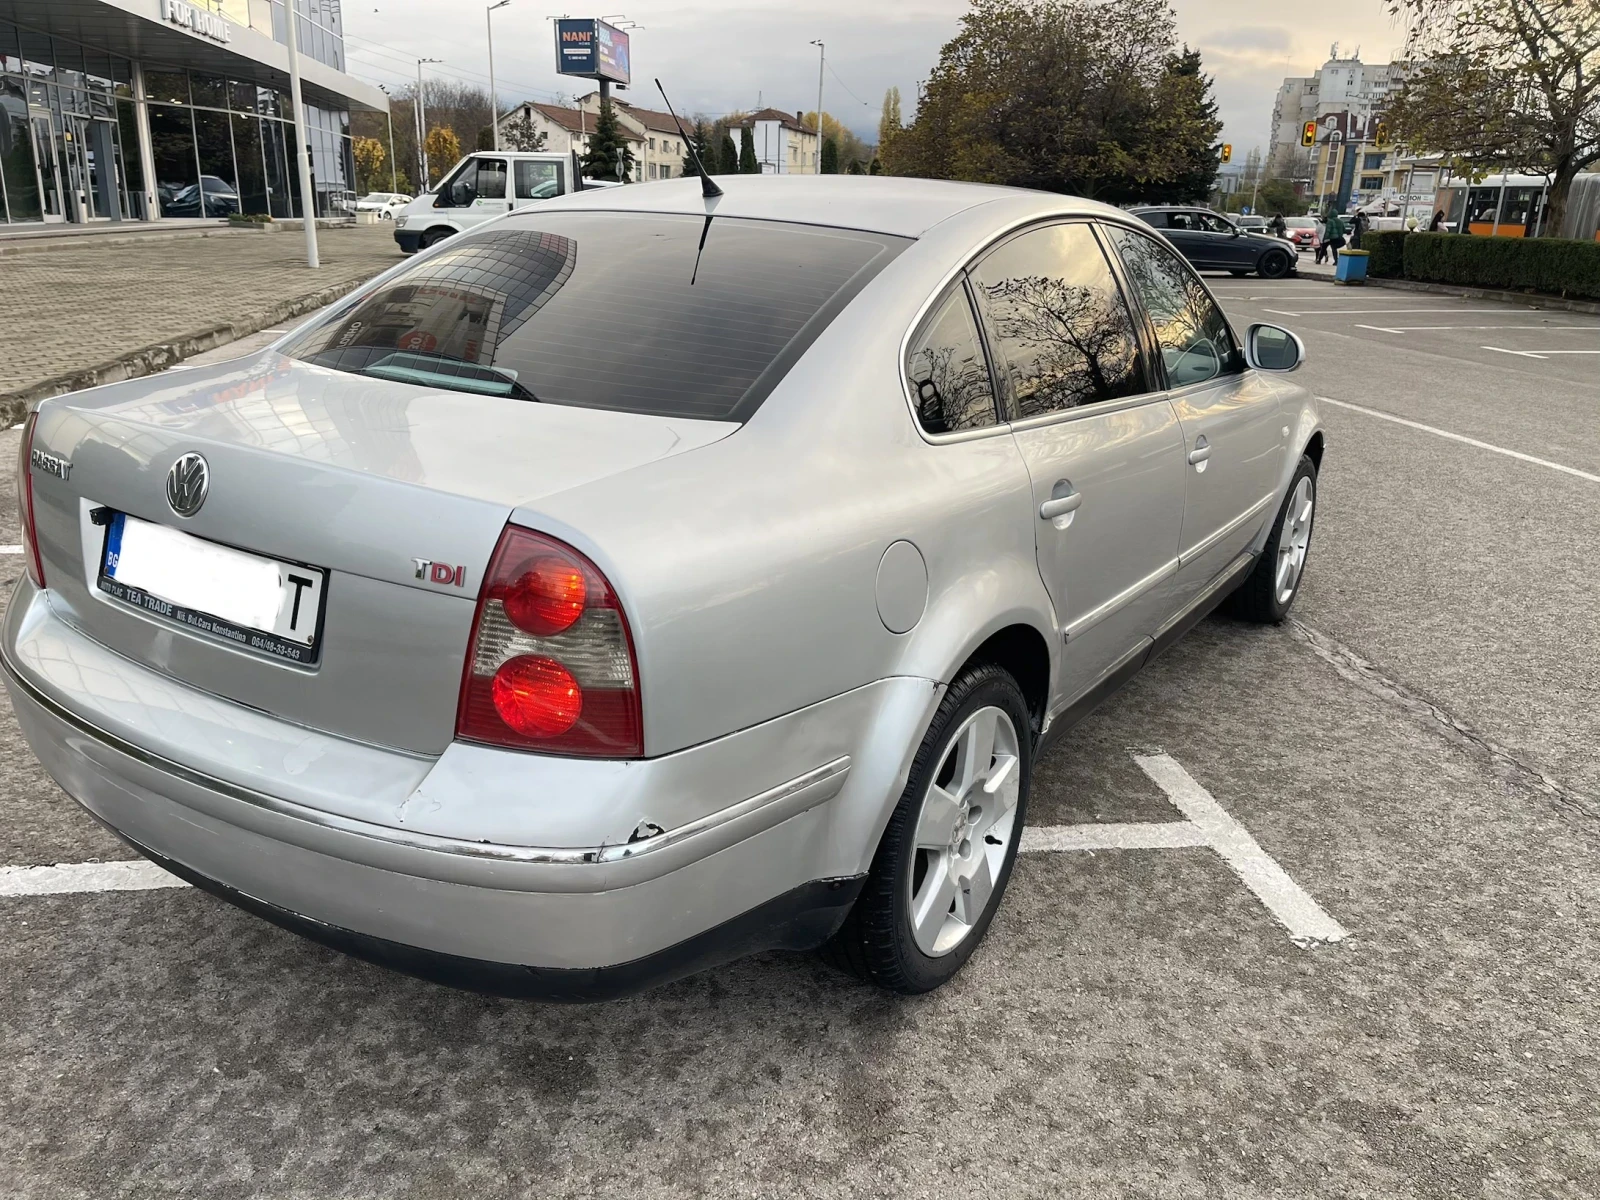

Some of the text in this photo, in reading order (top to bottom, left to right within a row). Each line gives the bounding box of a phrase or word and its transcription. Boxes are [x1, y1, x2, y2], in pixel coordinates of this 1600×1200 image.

[162, 0, 232, 43] FOR HOME
[562, 31, 592, 42] NANI
[32, 449, 73, 481] PASSAT
[107, 551, 119, 568] BG
[411, 556, 466, 587] TDI
[126, 589, 142, 605] TEA
[144, 595, 173, 616] TRADE
[211, 623, 247, 643] Konstantina
